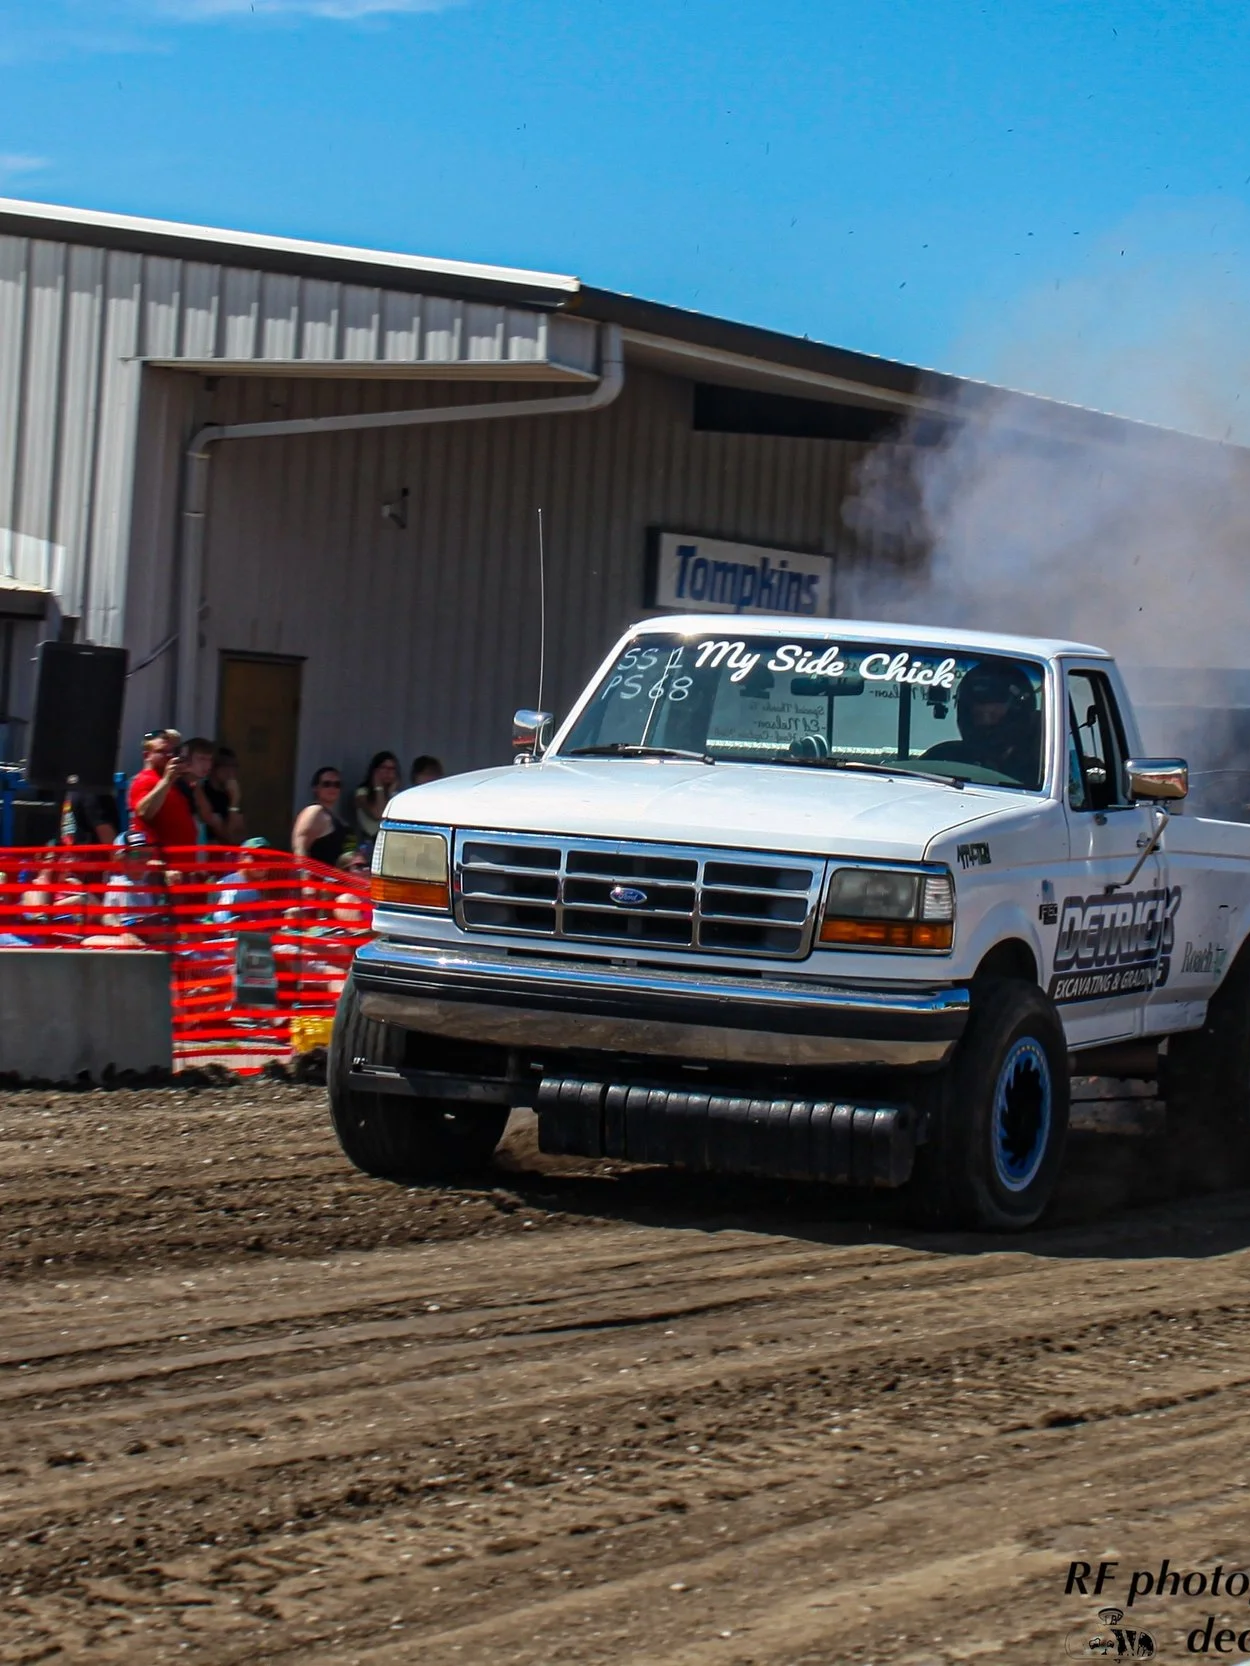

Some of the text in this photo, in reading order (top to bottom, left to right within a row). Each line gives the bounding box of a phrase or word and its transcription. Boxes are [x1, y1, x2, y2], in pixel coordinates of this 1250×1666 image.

[675, 545, 820, 614] Tompkins
[617, 647, 660, 670] SS
[695, 640, 761, 682] My
[767, 645, 845, 677] Side
[859, 652, 956, 688] Chick
[601, 674, 694, 701] PS 68
[1055, 891, 1181, 965] DETRICK
[1053, 972, 1113, 999] EXCAVATING
[1111, 970, 1119, 991] &
